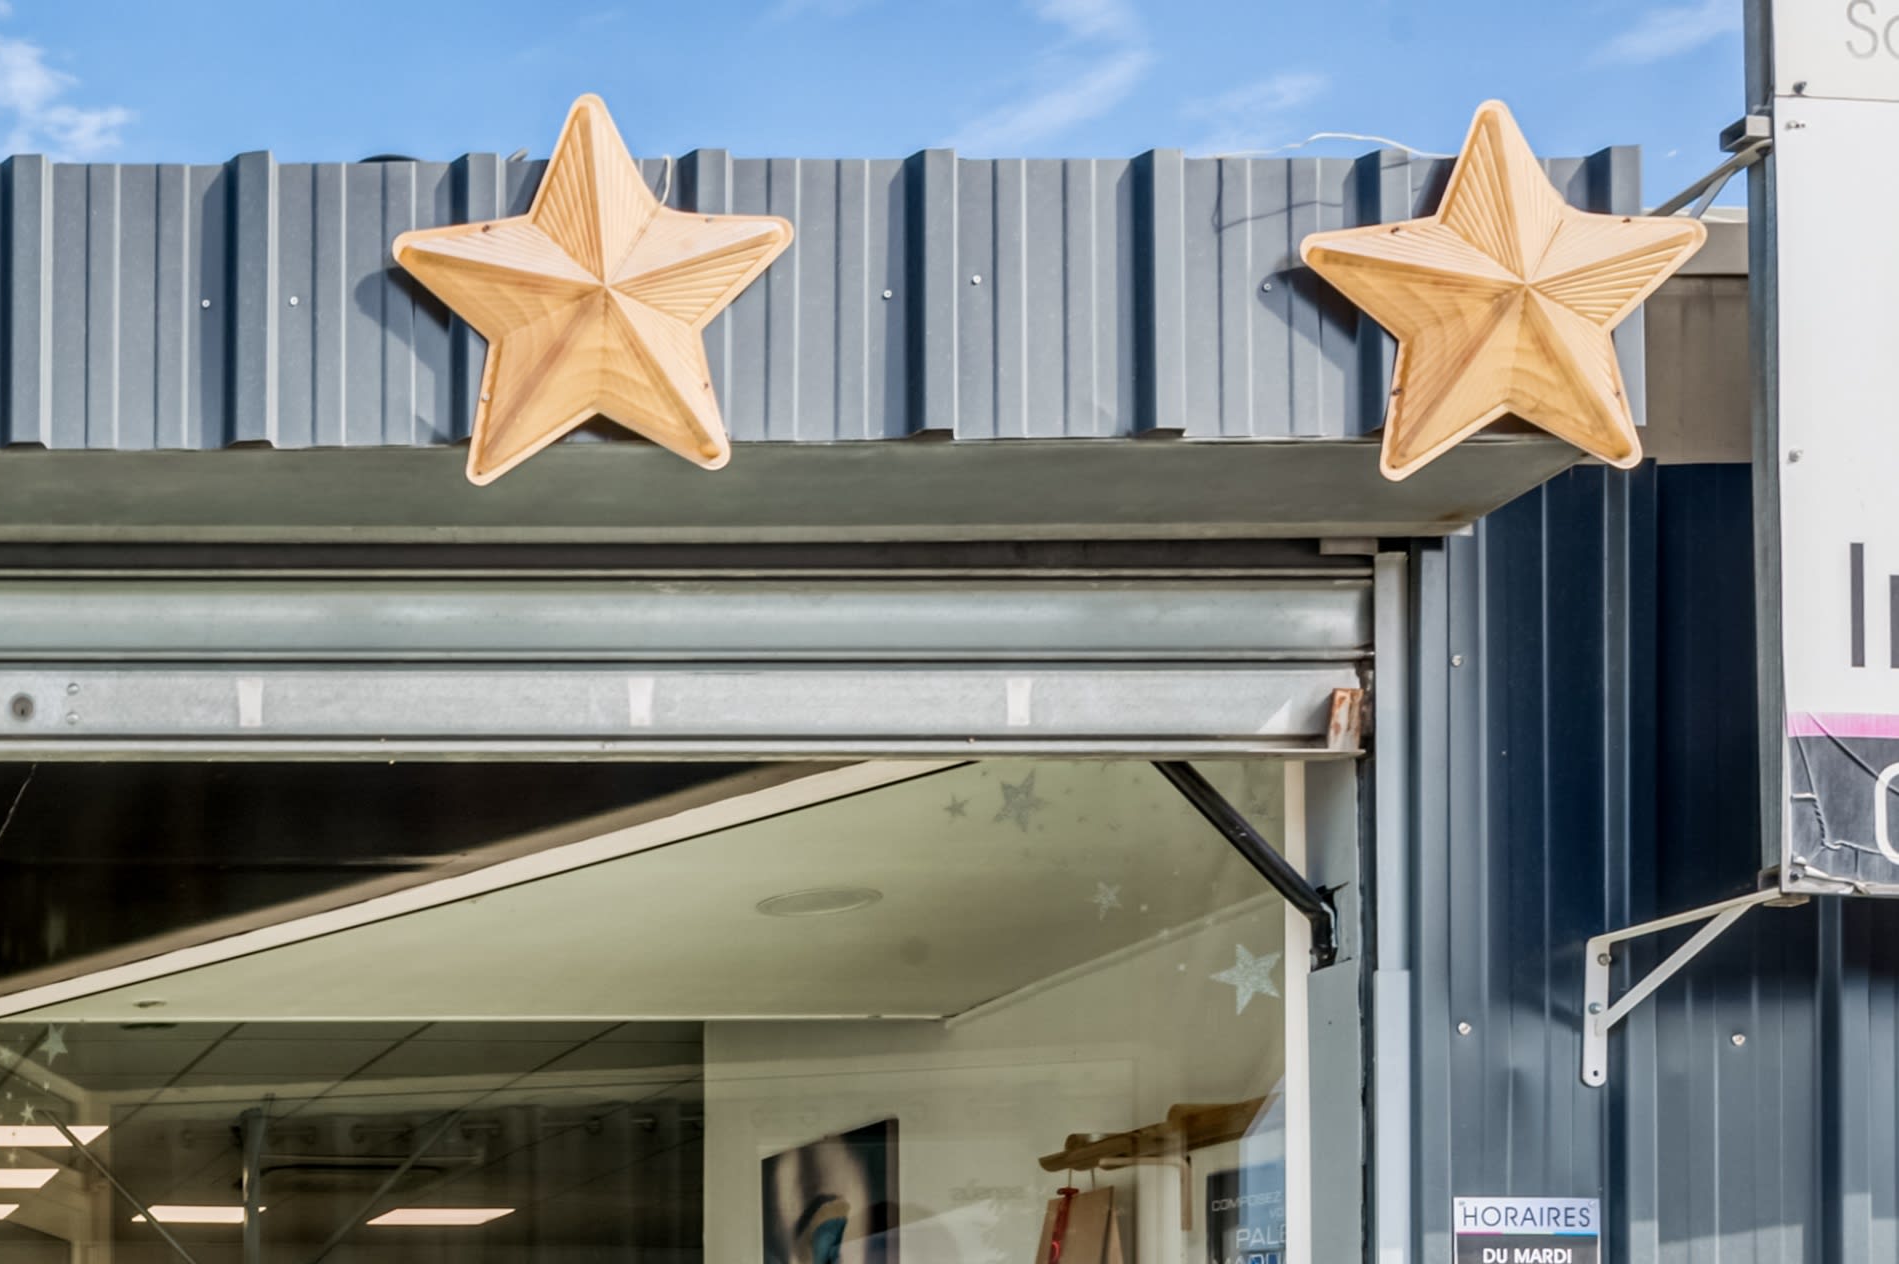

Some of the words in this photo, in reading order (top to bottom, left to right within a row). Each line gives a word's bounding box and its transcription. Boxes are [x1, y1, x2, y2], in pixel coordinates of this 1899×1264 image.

[1849, 541, 1899, 669] I
[1463, 1206, 1591, 1228] HORAIRES
[1483, 1248, 1508, 1264] DU
[1514, 1248, 1572, 1264] MARDI
